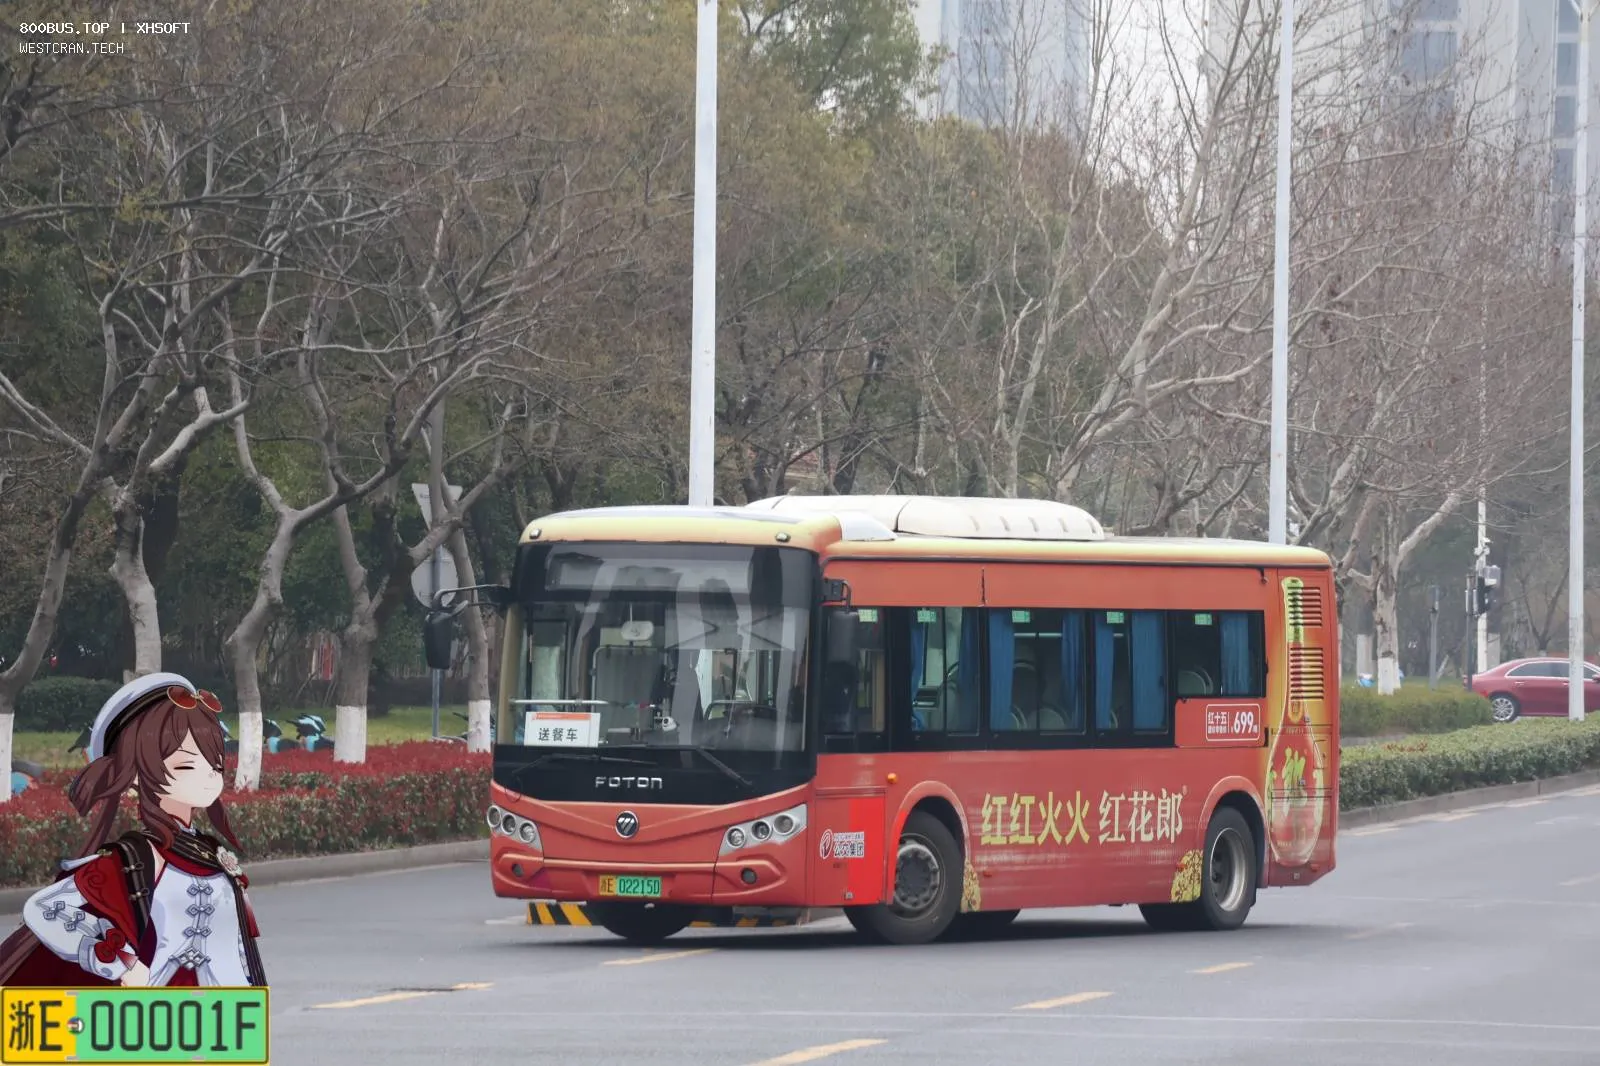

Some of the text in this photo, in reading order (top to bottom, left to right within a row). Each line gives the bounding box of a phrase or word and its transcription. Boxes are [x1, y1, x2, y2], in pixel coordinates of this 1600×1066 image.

[538, 727, 578, 742] 送餐车
[595, 776, 663, 789] FOTON
[980, 788, 1184, 846] 红红火火 红花郎
